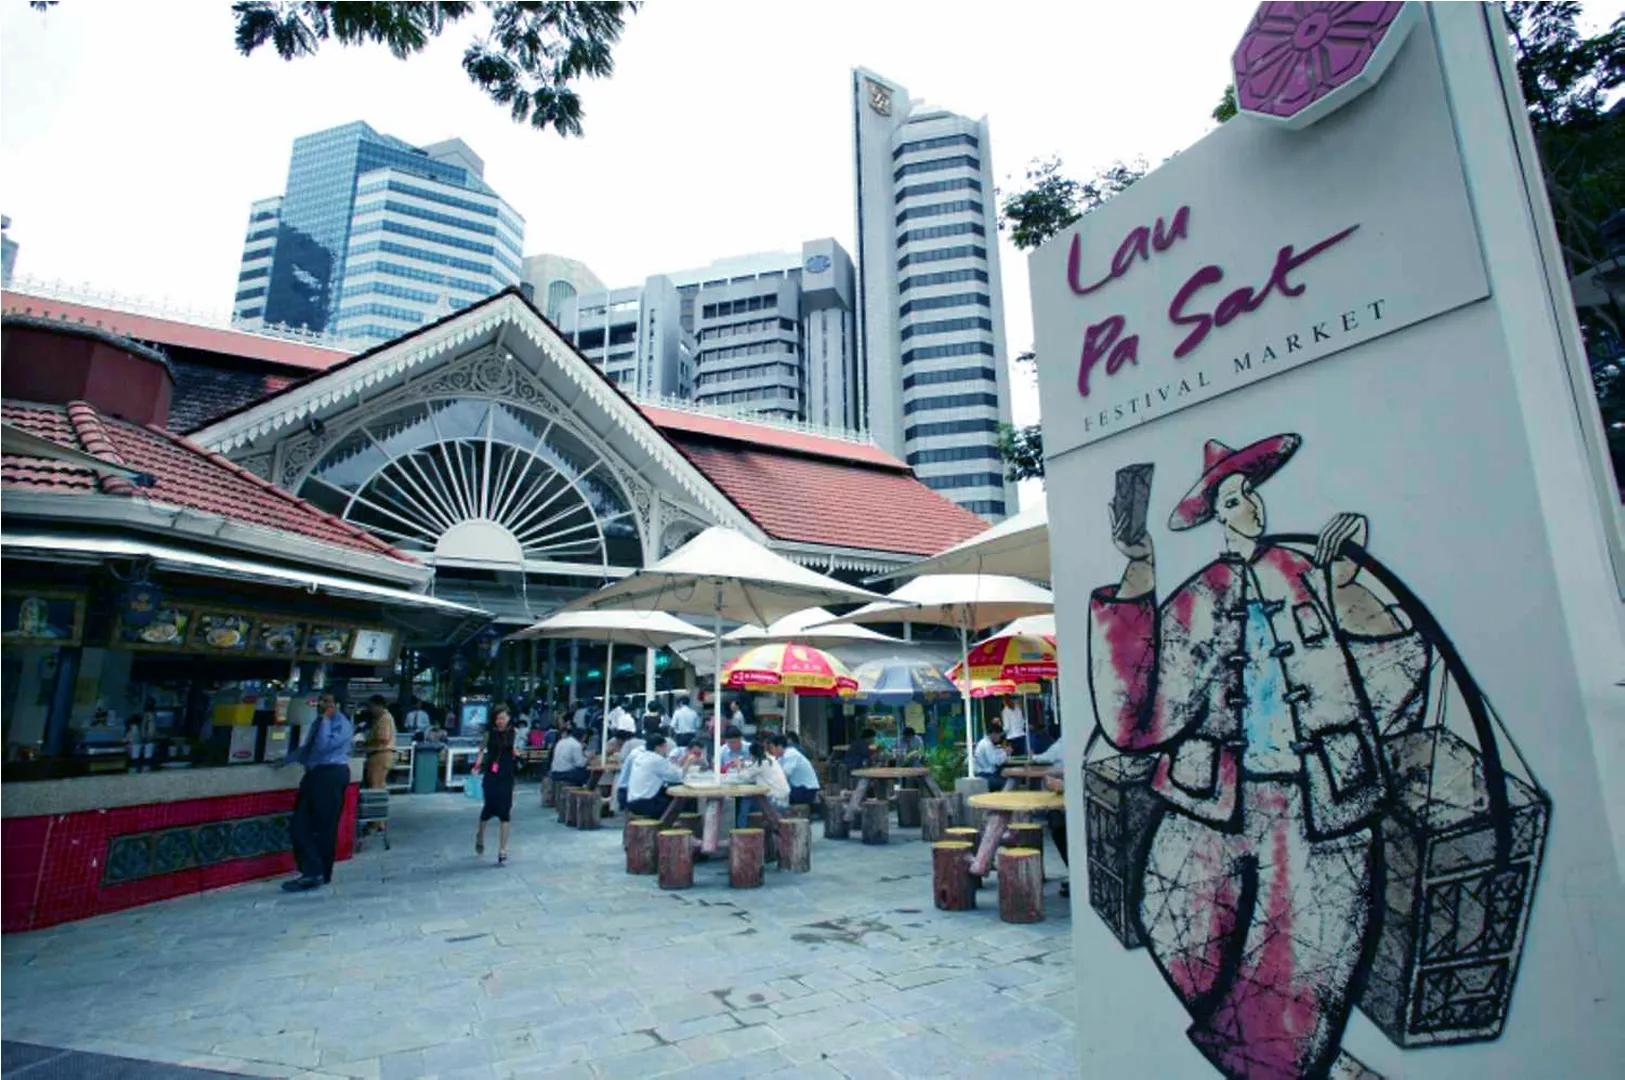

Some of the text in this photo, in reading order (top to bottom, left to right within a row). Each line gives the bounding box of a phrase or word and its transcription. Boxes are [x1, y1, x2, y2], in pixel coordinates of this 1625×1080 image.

[1067, 205, 1190, 295] Lau
[1078, 224, 1360, 397] Pa Sat
[1083, 298, 1385, 433] FESTIVAL MARKET
